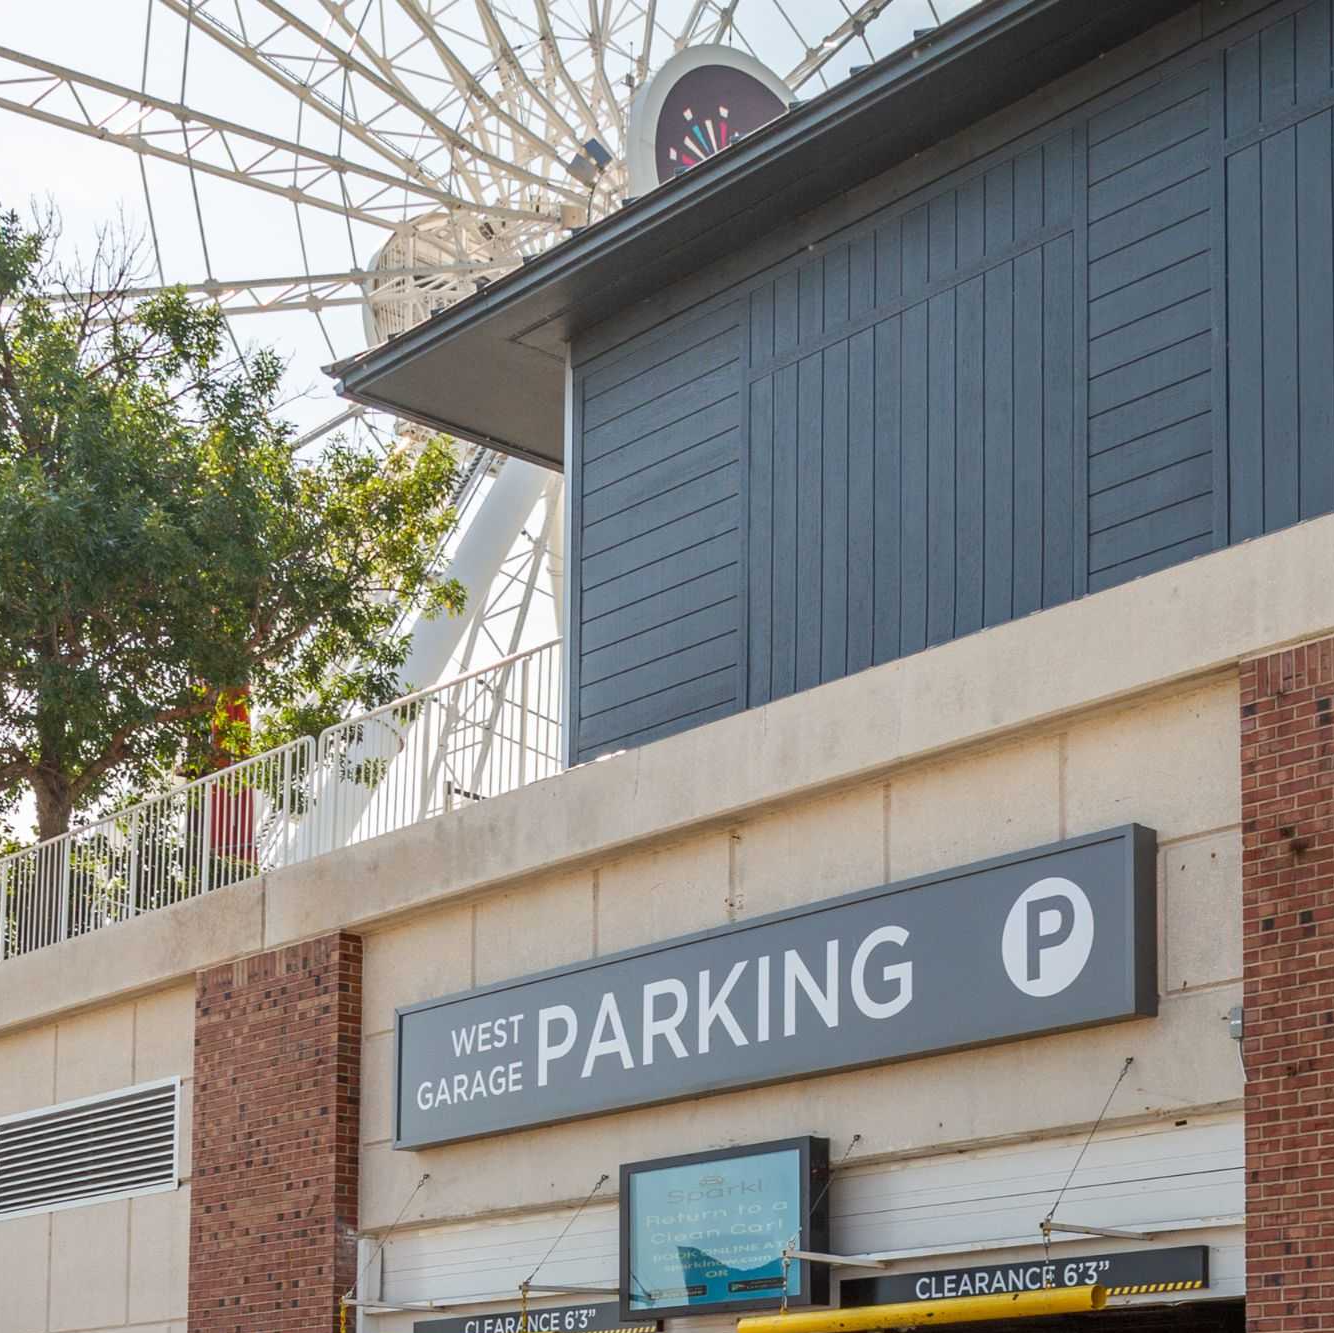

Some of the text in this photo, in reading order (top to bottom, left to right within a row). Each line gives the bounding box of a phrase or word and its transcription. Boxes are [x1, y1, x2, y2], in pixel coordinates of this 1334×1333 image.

[537, 893, 1076, 1087] PARKING P
[451, 1013, 524, 1058] WEST
[417, 1060, 523, 1111] GARAGE
[650, 1228, 720, 1246] Clean
[916, 1265, 1056, 1301] CLEARANCE
